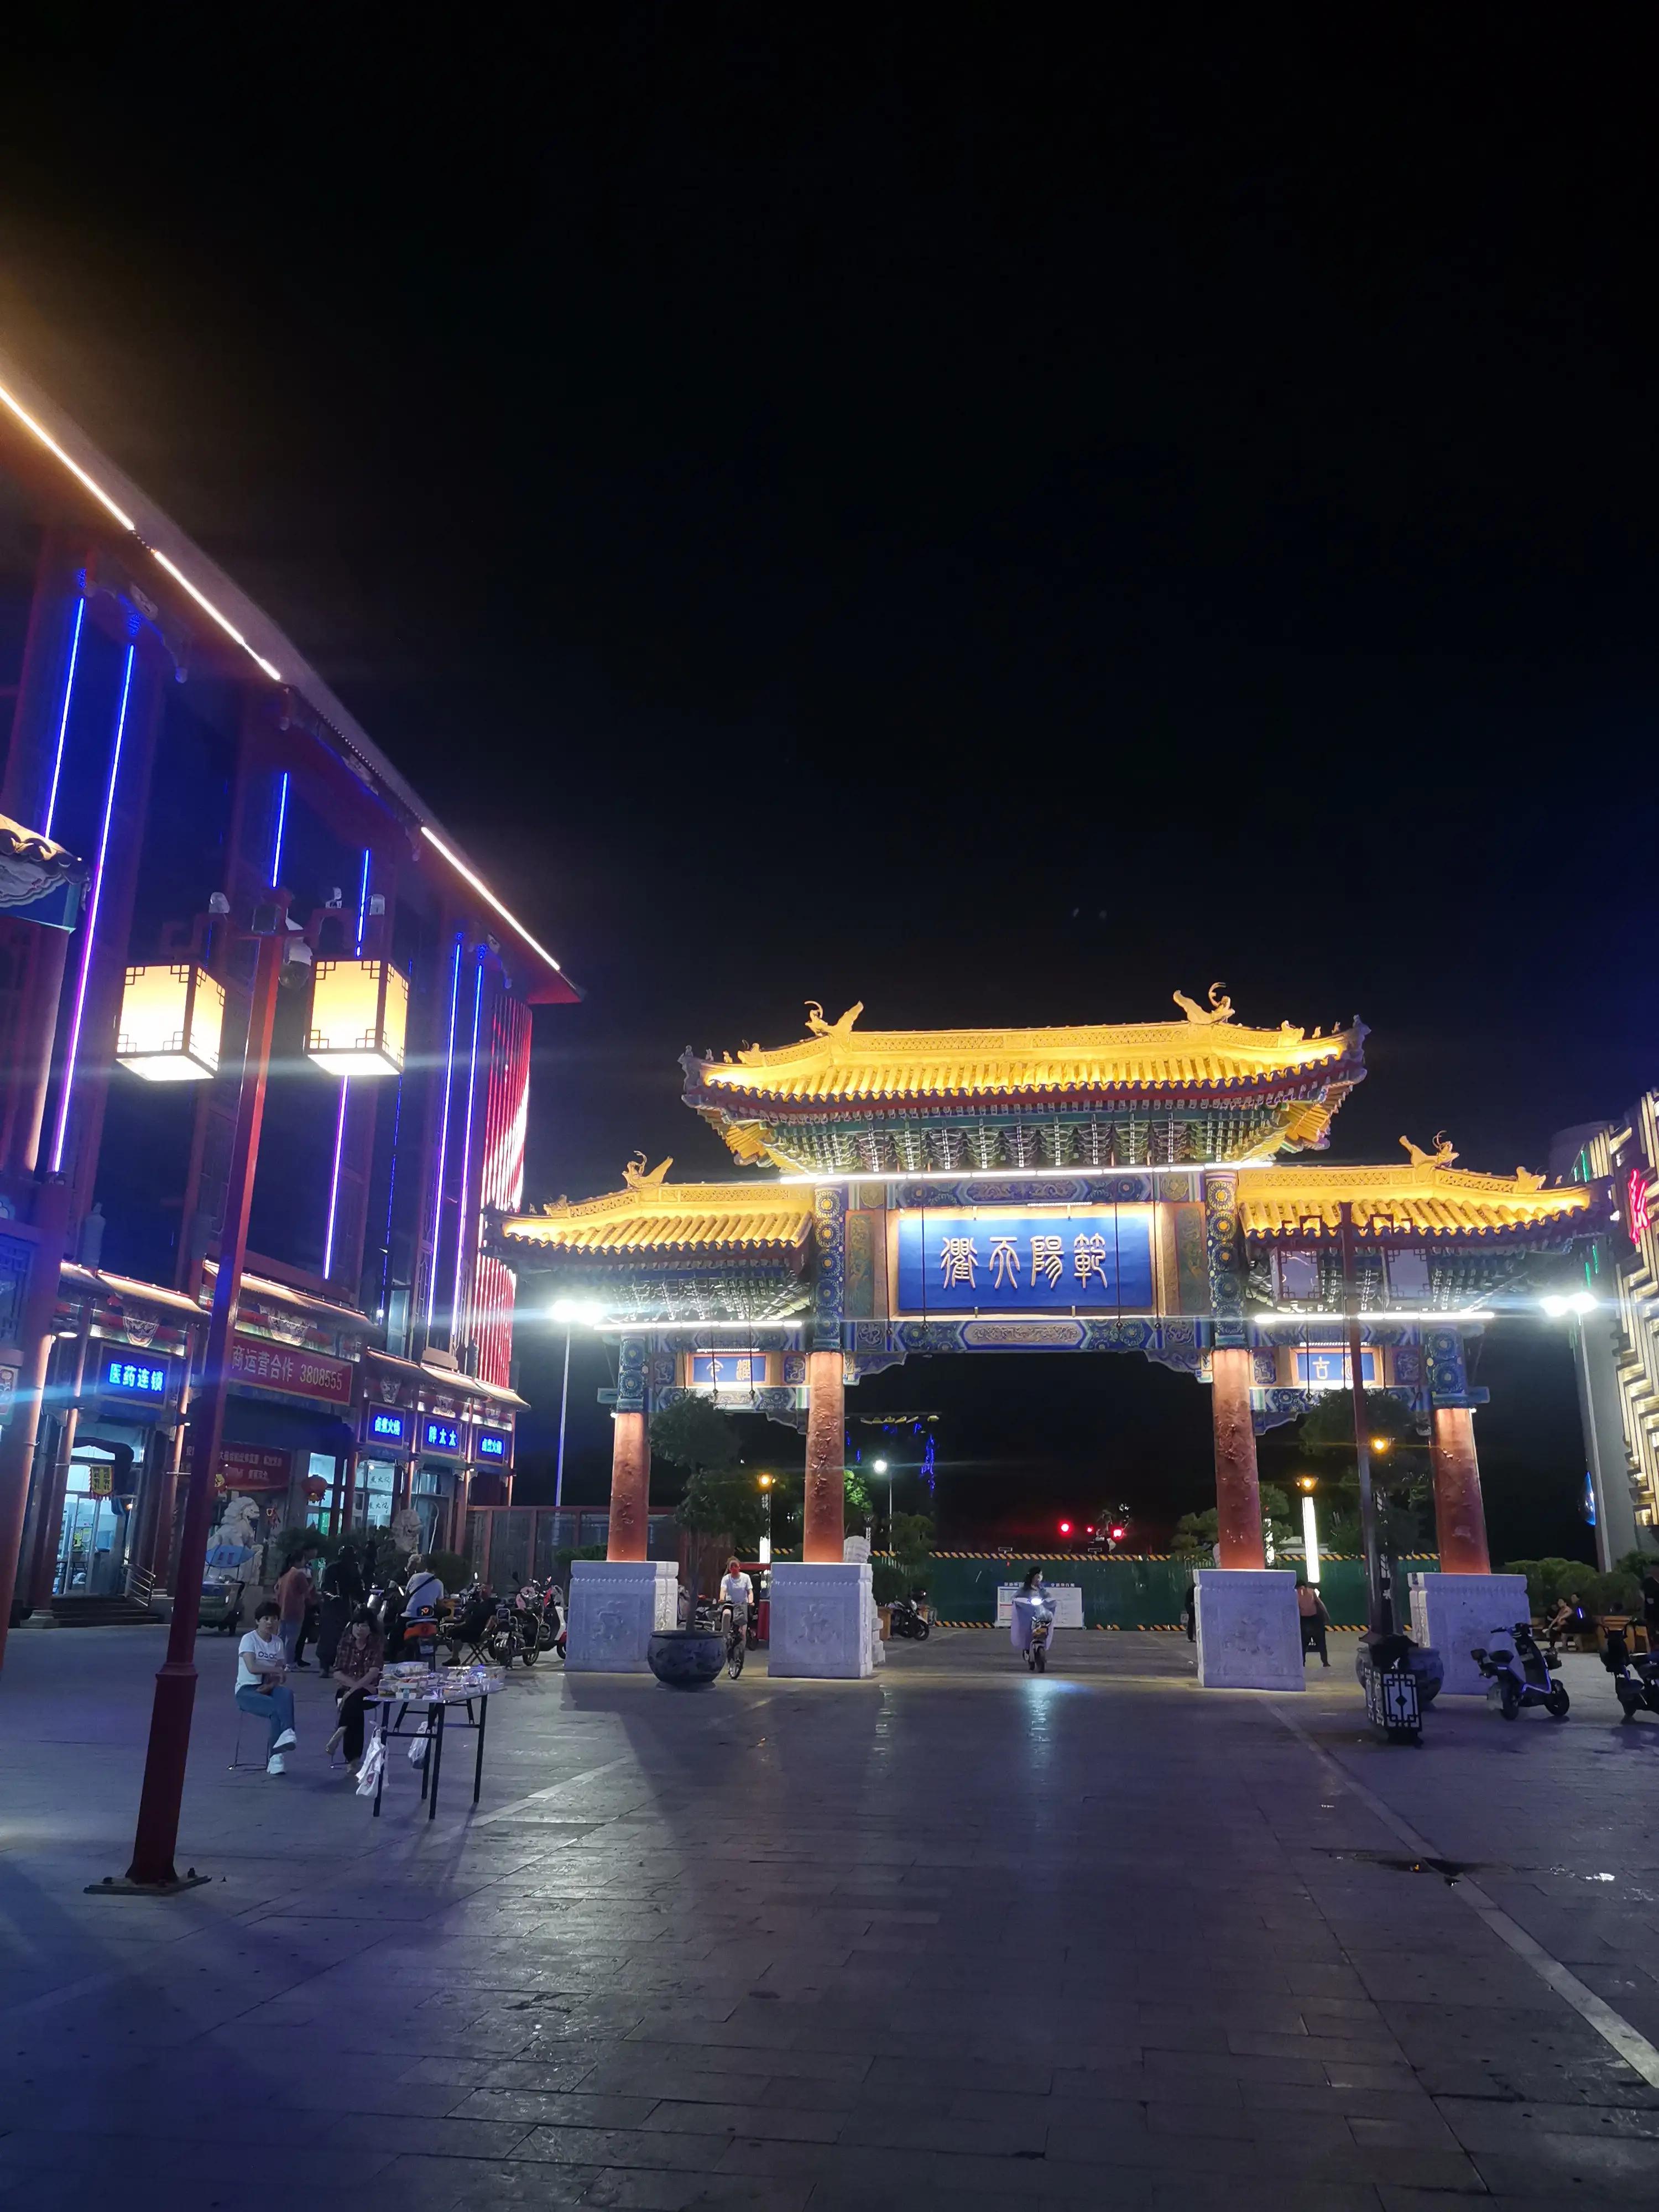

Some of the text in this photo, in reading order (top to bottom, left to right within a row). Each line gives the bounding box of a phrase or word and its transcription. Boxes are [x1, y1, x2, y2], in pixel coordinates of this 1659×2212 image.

[109, 1363, 164, 1391] 医药连锁
[299, 1364, 343, 1390] 3808555
